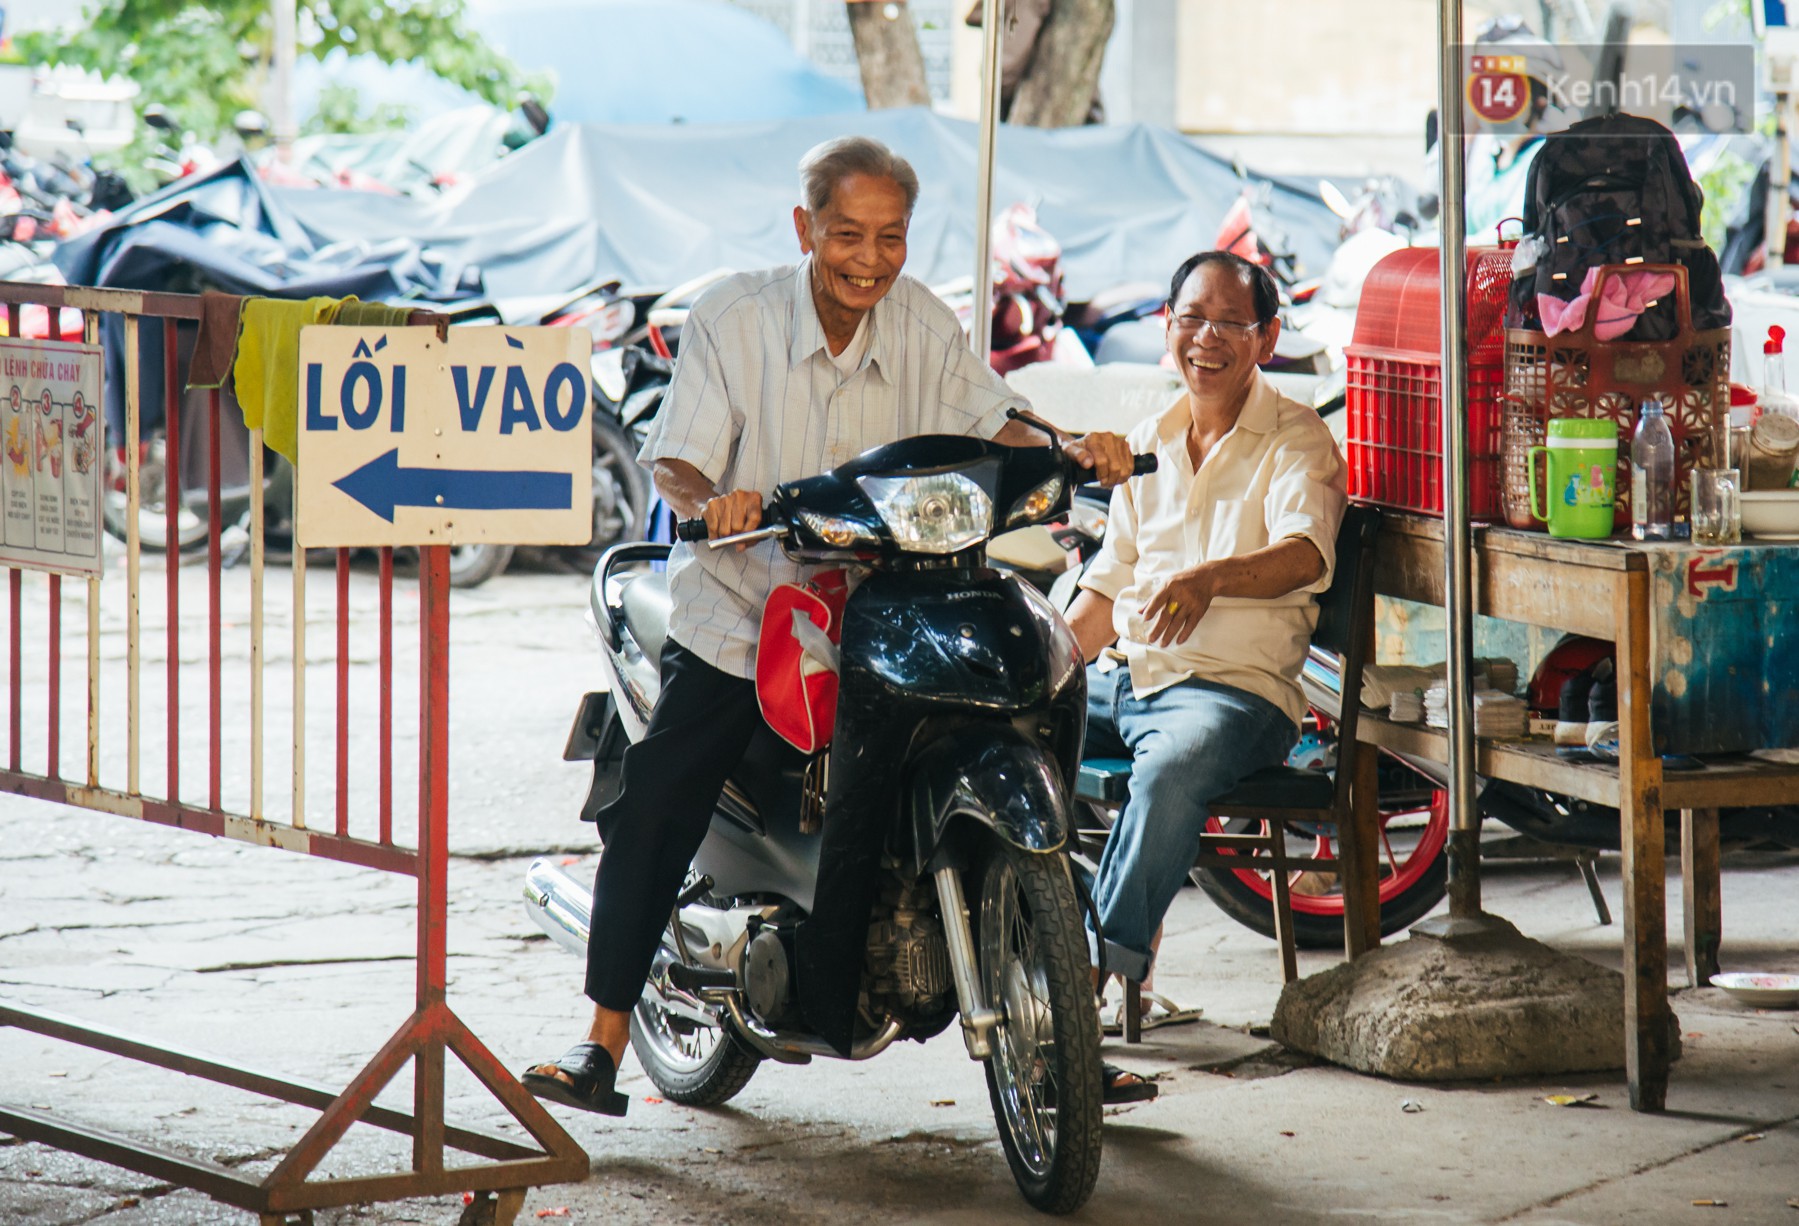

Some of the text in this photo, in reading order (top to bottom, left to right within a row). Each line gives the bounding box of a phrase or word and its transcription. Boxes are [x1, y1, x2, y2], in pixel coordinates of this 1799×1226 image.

[4, 354, 28, 381] LỆNH
[305, 334, 586, 435] LỐI VÀO
[946, 590, 1004, 601] HONDA
